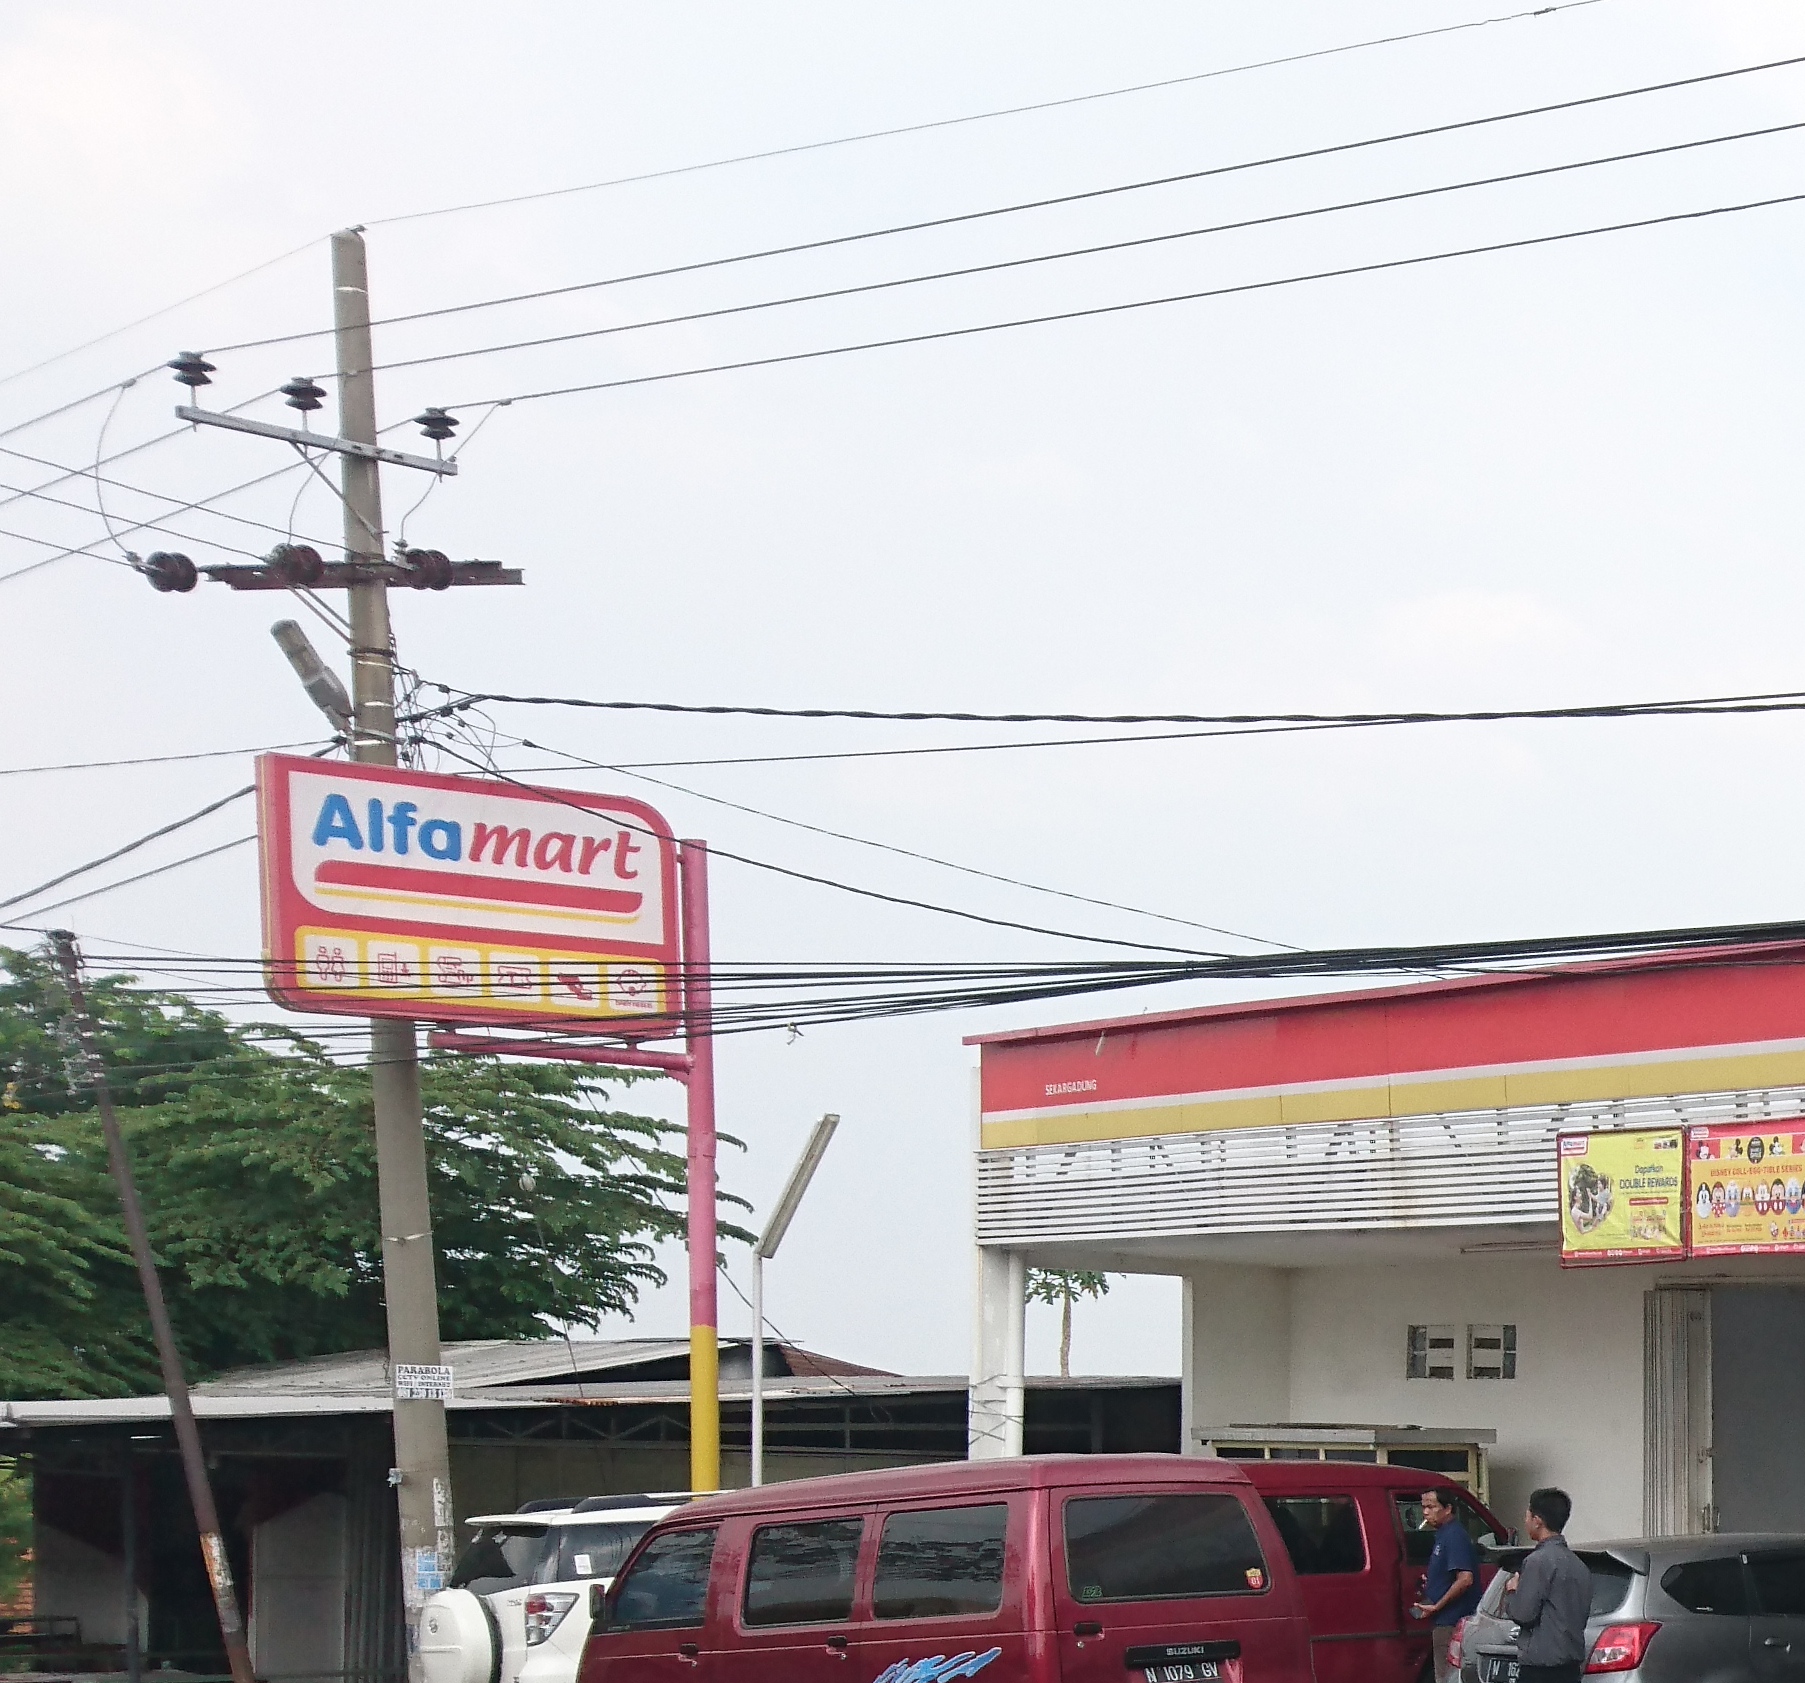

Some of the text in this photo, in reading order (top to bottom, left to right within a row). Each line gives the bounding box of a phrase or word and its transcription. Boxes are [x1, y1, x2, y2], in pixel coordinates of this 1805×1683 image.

[312, 793, 642, 880] Alfamart
[398, 1366, 450, 1375] PARABOLA
[1166, 1646, 1204, 1656] SUZUKI
[1144, 1661, 1218, 1683] N 1079 GV
